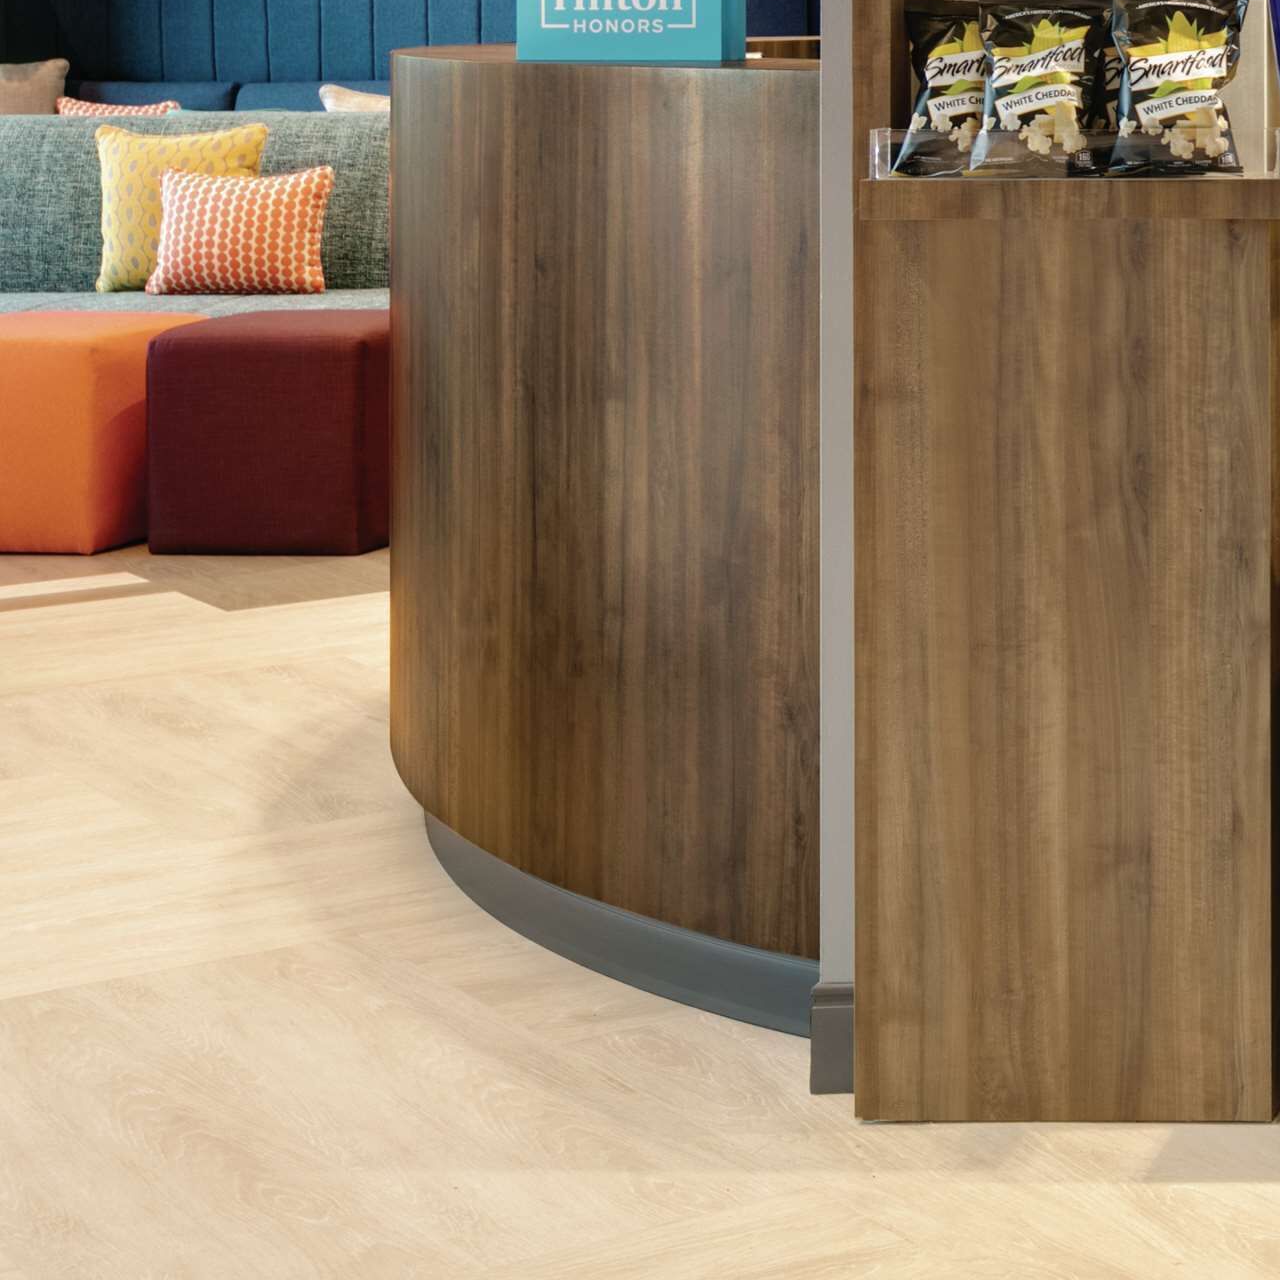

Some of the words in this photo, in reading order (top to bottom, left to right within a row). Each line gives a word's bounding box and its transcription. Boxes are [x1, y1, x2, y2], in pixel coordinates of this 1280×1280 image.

[573, 19, 664, 33] HONORS
[992, 44, 1083, 79] Smartfood
[1130, 49, 1225, 86] Smartfood
[934, 99, 966, 111] WHITE
[1002, 96, 1033, 111] WHITE
[1144, 101, 1174, 115] WHITE
